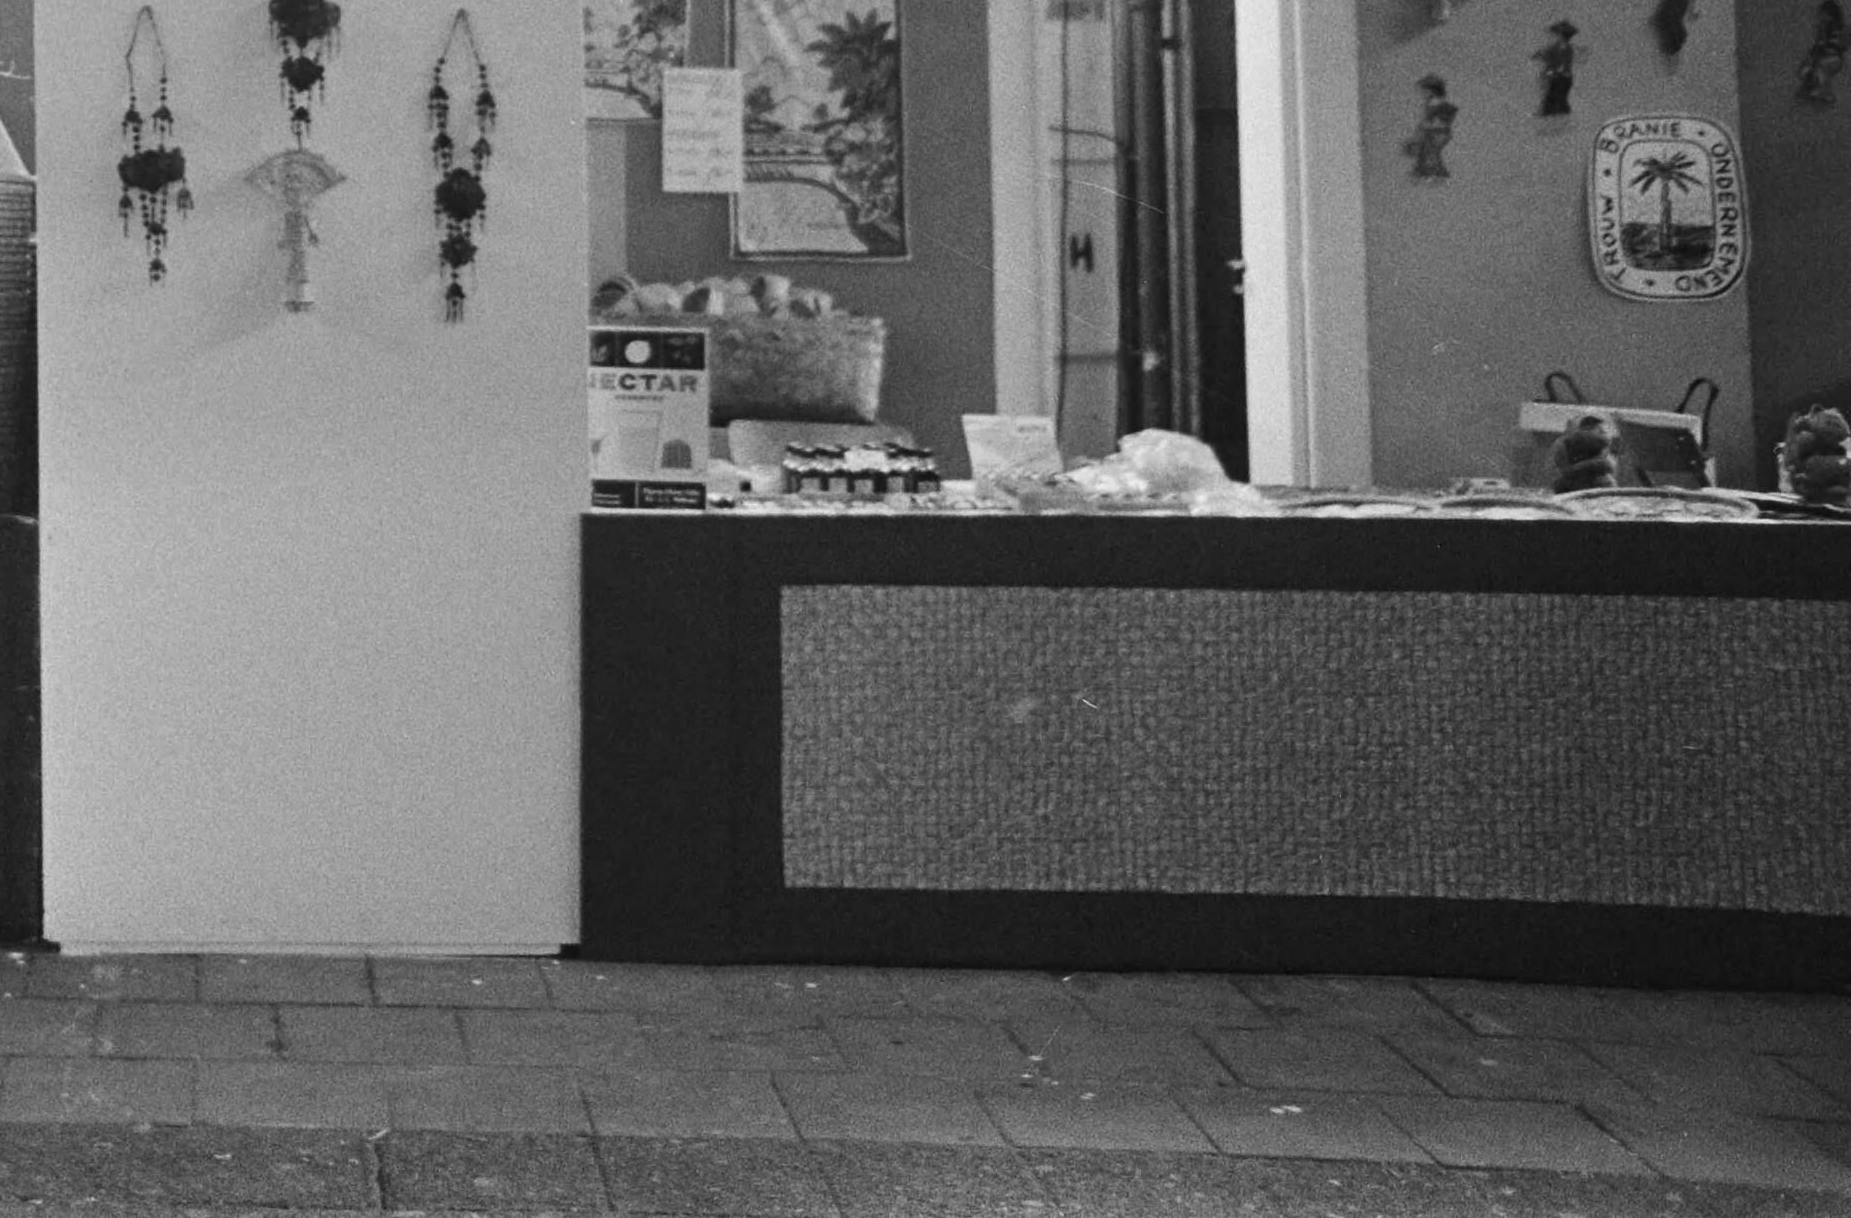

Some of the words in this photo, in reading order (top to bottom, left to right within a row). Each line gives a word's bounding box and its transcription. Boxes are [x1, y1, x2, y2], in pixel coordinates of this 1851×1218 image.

[1598, 121, 1681, 154] BRANIE
[1599, 194, 1628, 283] TROUW
[1674, 142, 1739, 292] ONDERNEMEND
